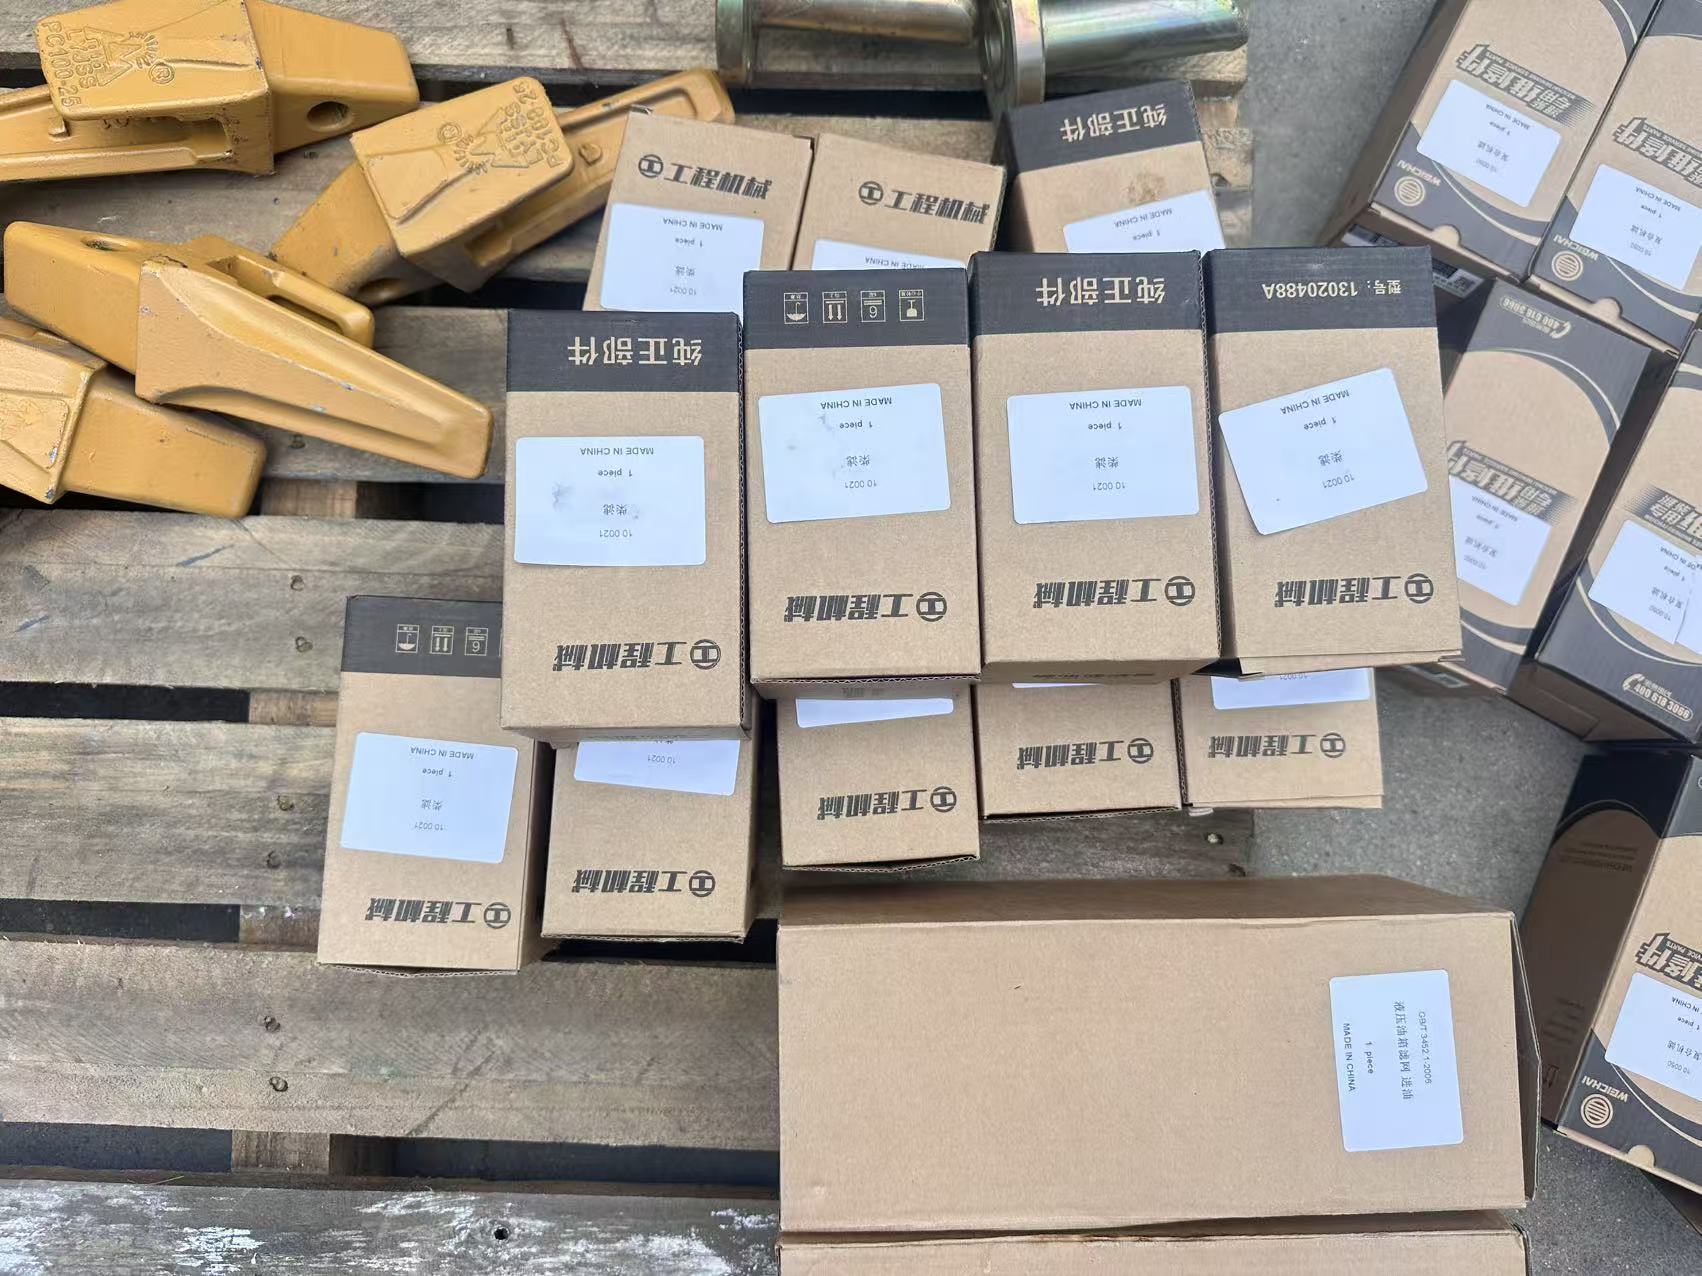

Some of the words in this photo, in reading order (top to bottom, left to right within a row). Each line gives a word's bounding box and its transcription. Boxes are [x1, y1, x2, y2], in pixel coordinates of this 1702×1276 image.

[1060, 104, 1167, 142] 纯正部件
[664, 163, 773, 199] 工程机械
[884, 189, 990, 224] 工程机械
[1139, 214, 1149, 222] IN
[1149, 208, 1173, 219] MADE
[662, 217, 688, 227] CHINA
[699, 222, 723, 231] MADE
[1114, 216, 1138, 228] CHINA
[865, 257, 889, 266] CHINA
[1036, 276, 1165, 307] 纯正部件
[567, 336, 702, 366] 纯正部件
[865, 397, 892, 407] MADE
[1311, 398, 1321, 406] IN
[1322, 389, 1350, 404] MADE
[820, 400, 850, 410] CHINA
[852, 399, 862, 407] IN
[1070, 401, 1099, 410] CHINA
[1114, 399, 1142, 408] MADE
[1280, 400, 1310, 415] CHINA
[839, 420, 863, 429] piece
[1088, 421, 1112, 430] piece
[1303, 418, 1327, 431] piece
[580, 447, 610, 456] CHINA
[613, 448, 623, 456] IN
[626, 447, 654, 456] MADE
[598, 469, 623, 477] piece
[1033, 578, 1162, 608] 工程机械
[1274, 576, 1401, 608] 工程机械
[784, 593, 914, 623] 工程机械
[552, 641, 688, 672] 工程机械
[1634, 683, 1651, 698] 400
[1651, 693, 1667, 707] 618
[1667, 701, 1690, 719] 3066
[410, 747, 437, 756] CHINA
[1208, 734, 1317, 759] 工程机械
[438, 749, 447, 757] IN
[449, 751, 474, 760] MADE
[1016, 740, 1125, 770] 工程机械
[422, 768, 443, 777] piece
[817, 789, 927, 821] 工程机械
[571, 869, 688, 894] 工程机械
[364, 897, 482, 924] 工程机械
[1666, 941, 1686, 954] PARTS
[1672, 997, 1692, 1010] CHINA
[1677, 1017, 1694, 1027] piece
[1343, 1023, 1352, 1049] MADE
[1345, 1051, 1353, 1061] IN
[1364, 1051, 1374, 1074] piece
[1346, 1063, 1356, 1092] CHINA
[1581, 1075, 1628, 1103] WEICHAI
